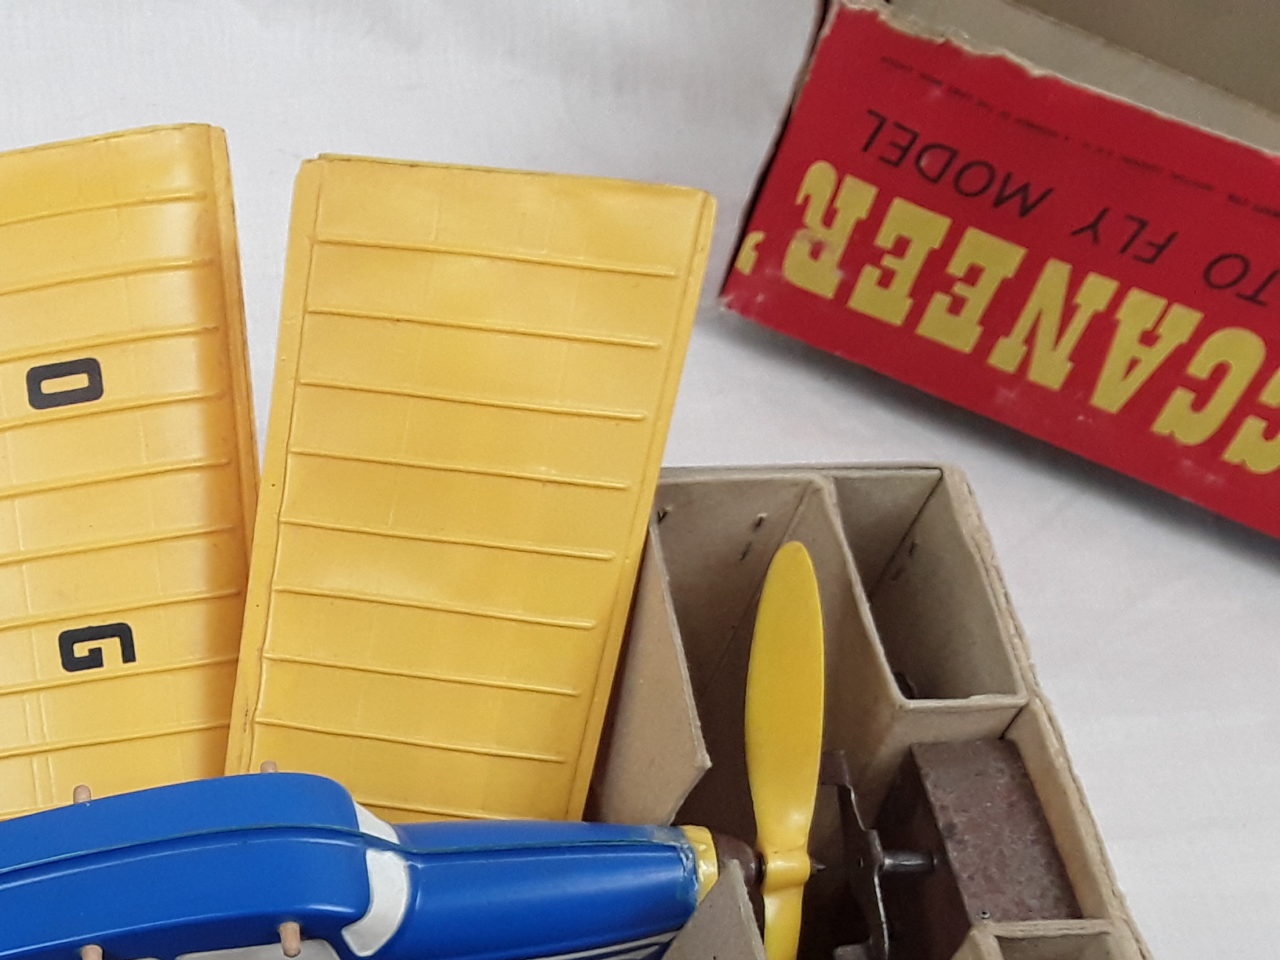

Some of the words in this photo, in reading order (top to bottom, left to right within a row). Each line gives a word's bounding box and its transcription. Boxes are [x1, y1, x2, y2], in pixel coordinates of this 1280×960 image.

[861, 109, 1055, 219] MODEL
[1071, 206, 1179, 266] FLY
[1202, 253, 1280, 306] TO
